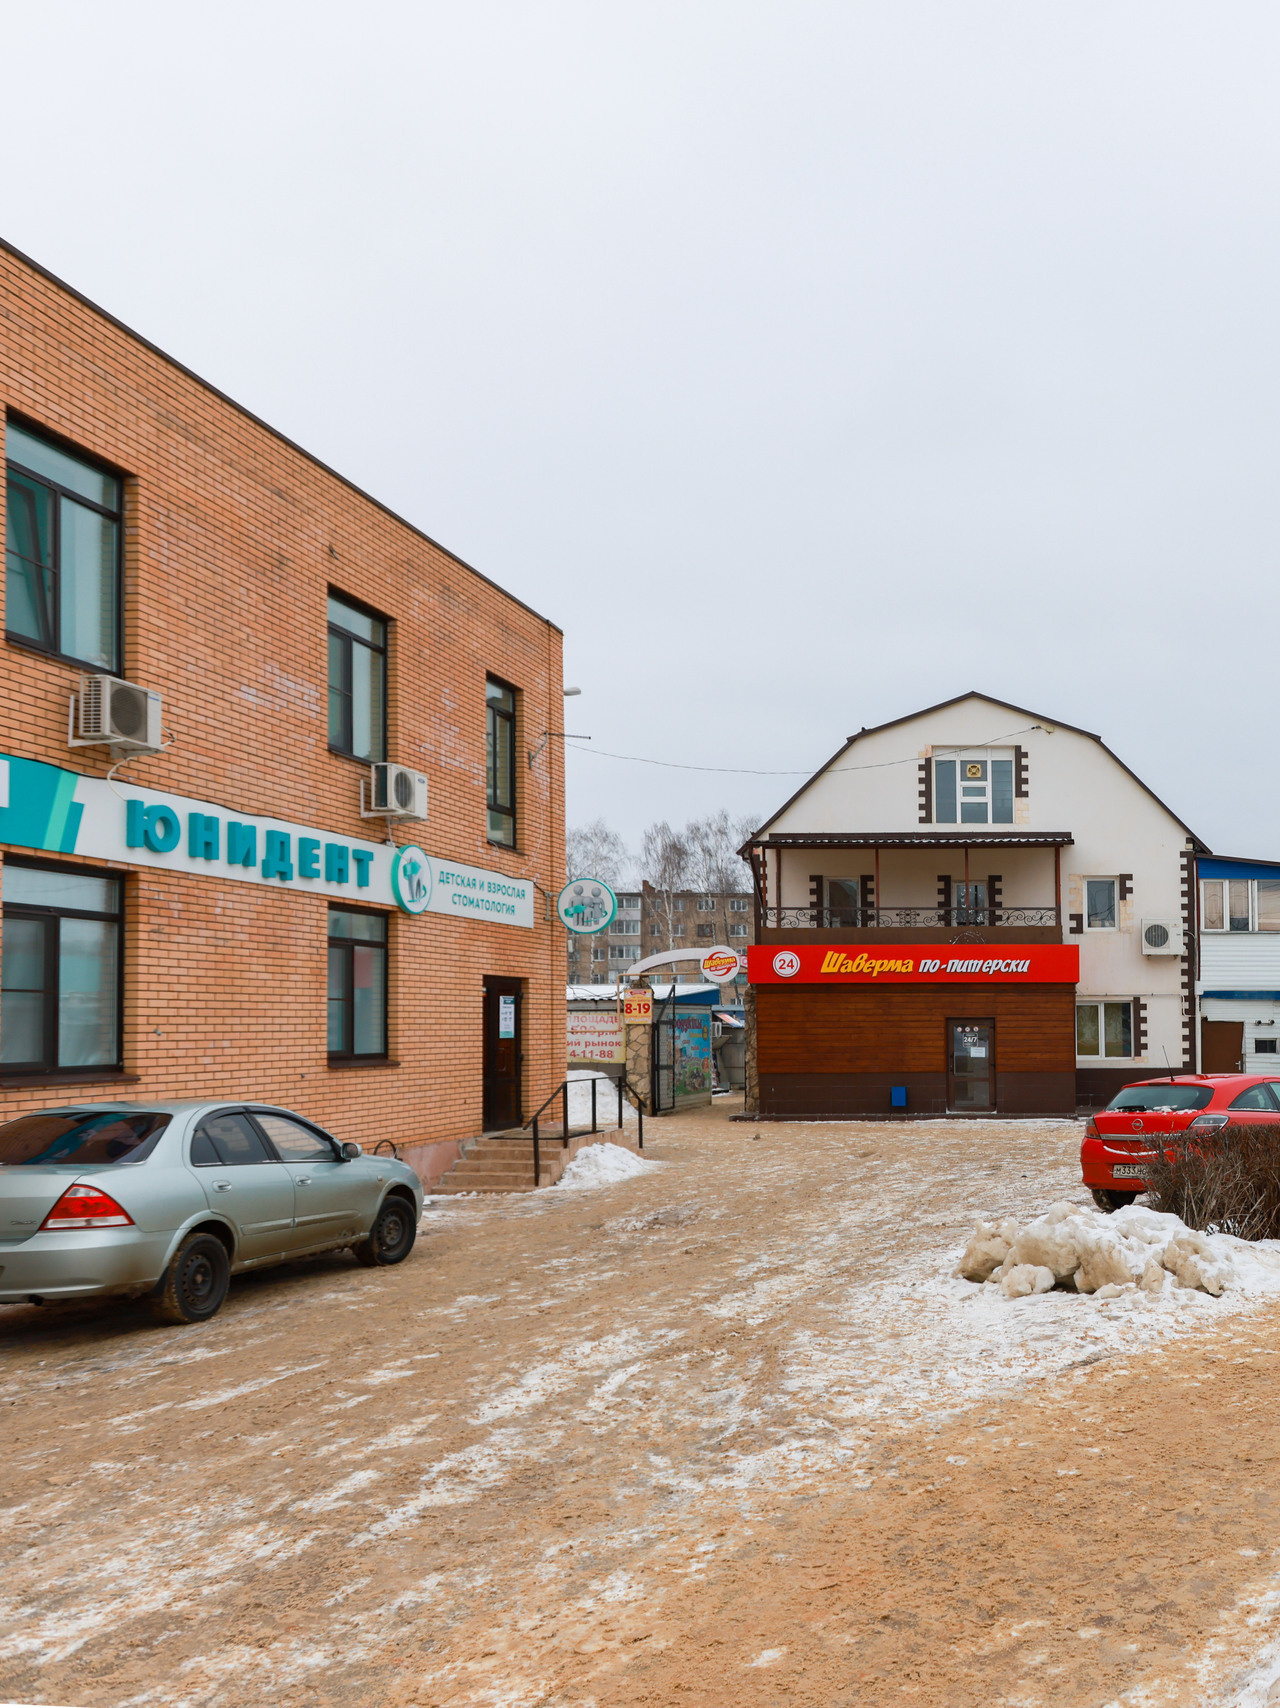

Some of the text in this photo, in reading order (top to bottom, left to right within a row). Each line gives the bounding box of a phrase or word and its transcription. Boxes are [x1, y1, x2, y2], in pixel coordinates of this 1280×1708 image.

[126, 799, 374, 888] ЮНИДЕНТ
[439, 870, 526, 900] ДЕТСКАЯ И ВЗРОСЛАЯ
[451, 892, 516, 916] СТОМАТОЛОГИЯ
[778, 958, 795, 970] 24
[820, 950, 1031, 978] Шаверма по-питерски
[624, 1002, 651, 1014] 8-19
[584, 1040, 621, 1049] рынок
